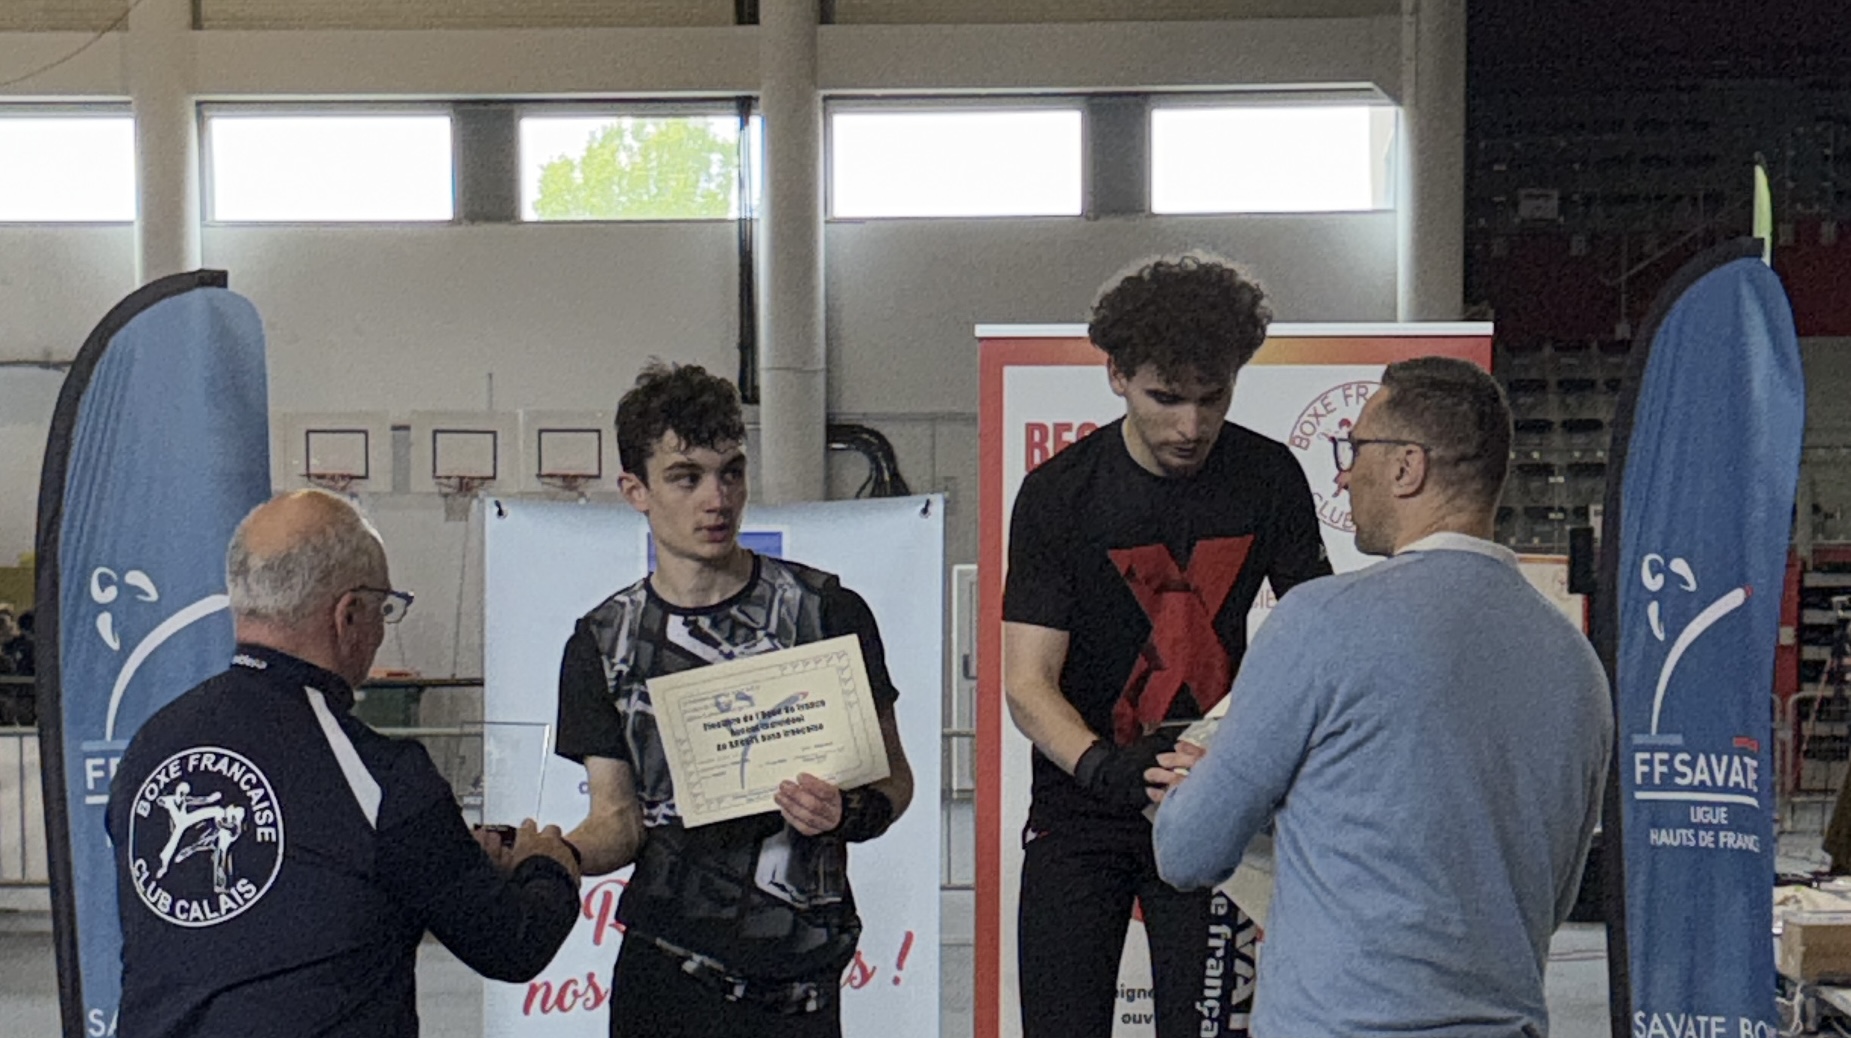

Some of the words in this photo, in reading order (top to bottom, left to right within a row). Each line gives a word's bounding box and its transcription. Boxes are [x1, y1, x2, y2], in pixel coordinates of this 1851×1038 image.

[1290, 395, 1337, 451] BOXE
[136, 759, 182, 818] BOXE
[188, 753, 277, 843] FRANCAISE
[1690, 806, 1728, 824] LIGUE
[1650, 828, 1696, 848] HAUTS
[1699, 830, 1716, 848] DE
[133, 858, 172, 914] CLUB
[175, 878, 257, 921] CALAIS
[522, 971, 610, 1016] nos
